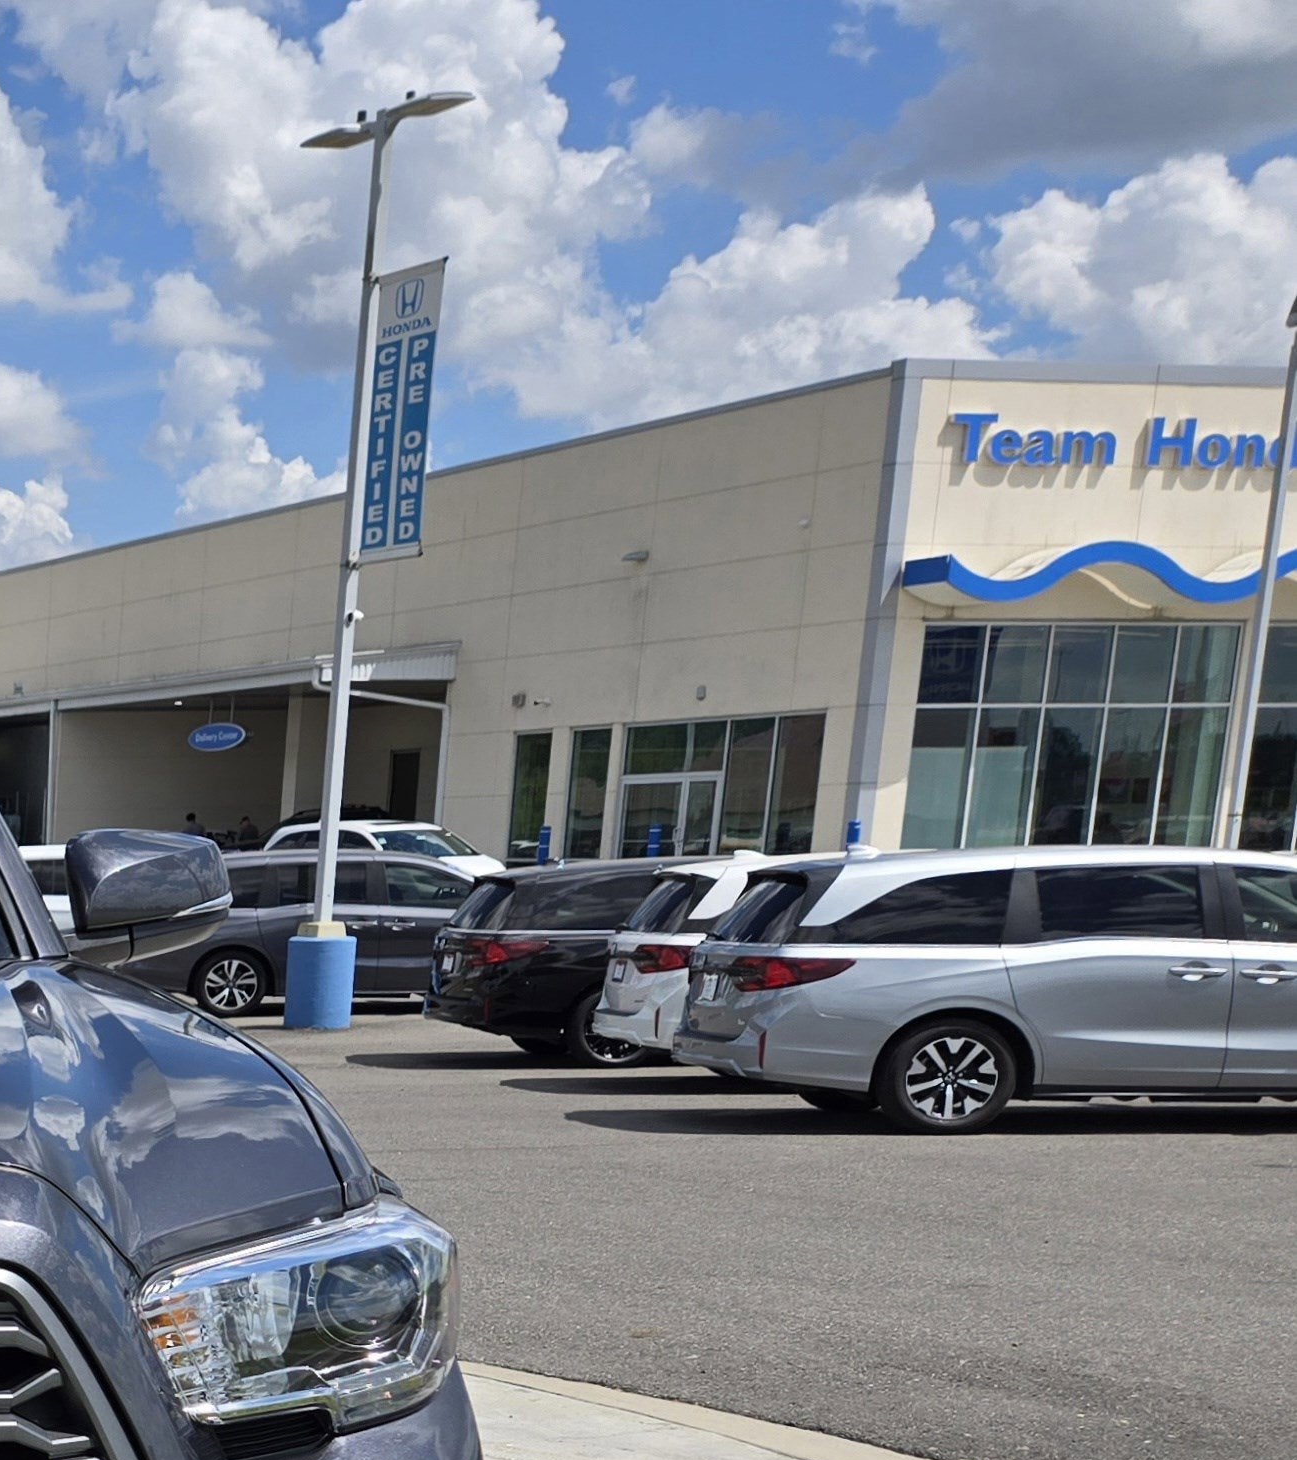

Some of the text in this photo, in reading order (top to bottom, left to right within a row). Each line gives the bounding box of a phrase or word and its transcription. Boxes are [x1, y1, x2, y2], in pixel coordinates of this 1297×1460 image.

[381, 317, 433, 338] HONDA
[365, 346, 398, 546] CERTIFIED
[399, 338, 429, 540] PRE OWNED
[952, 413, 1117, 466] Team
